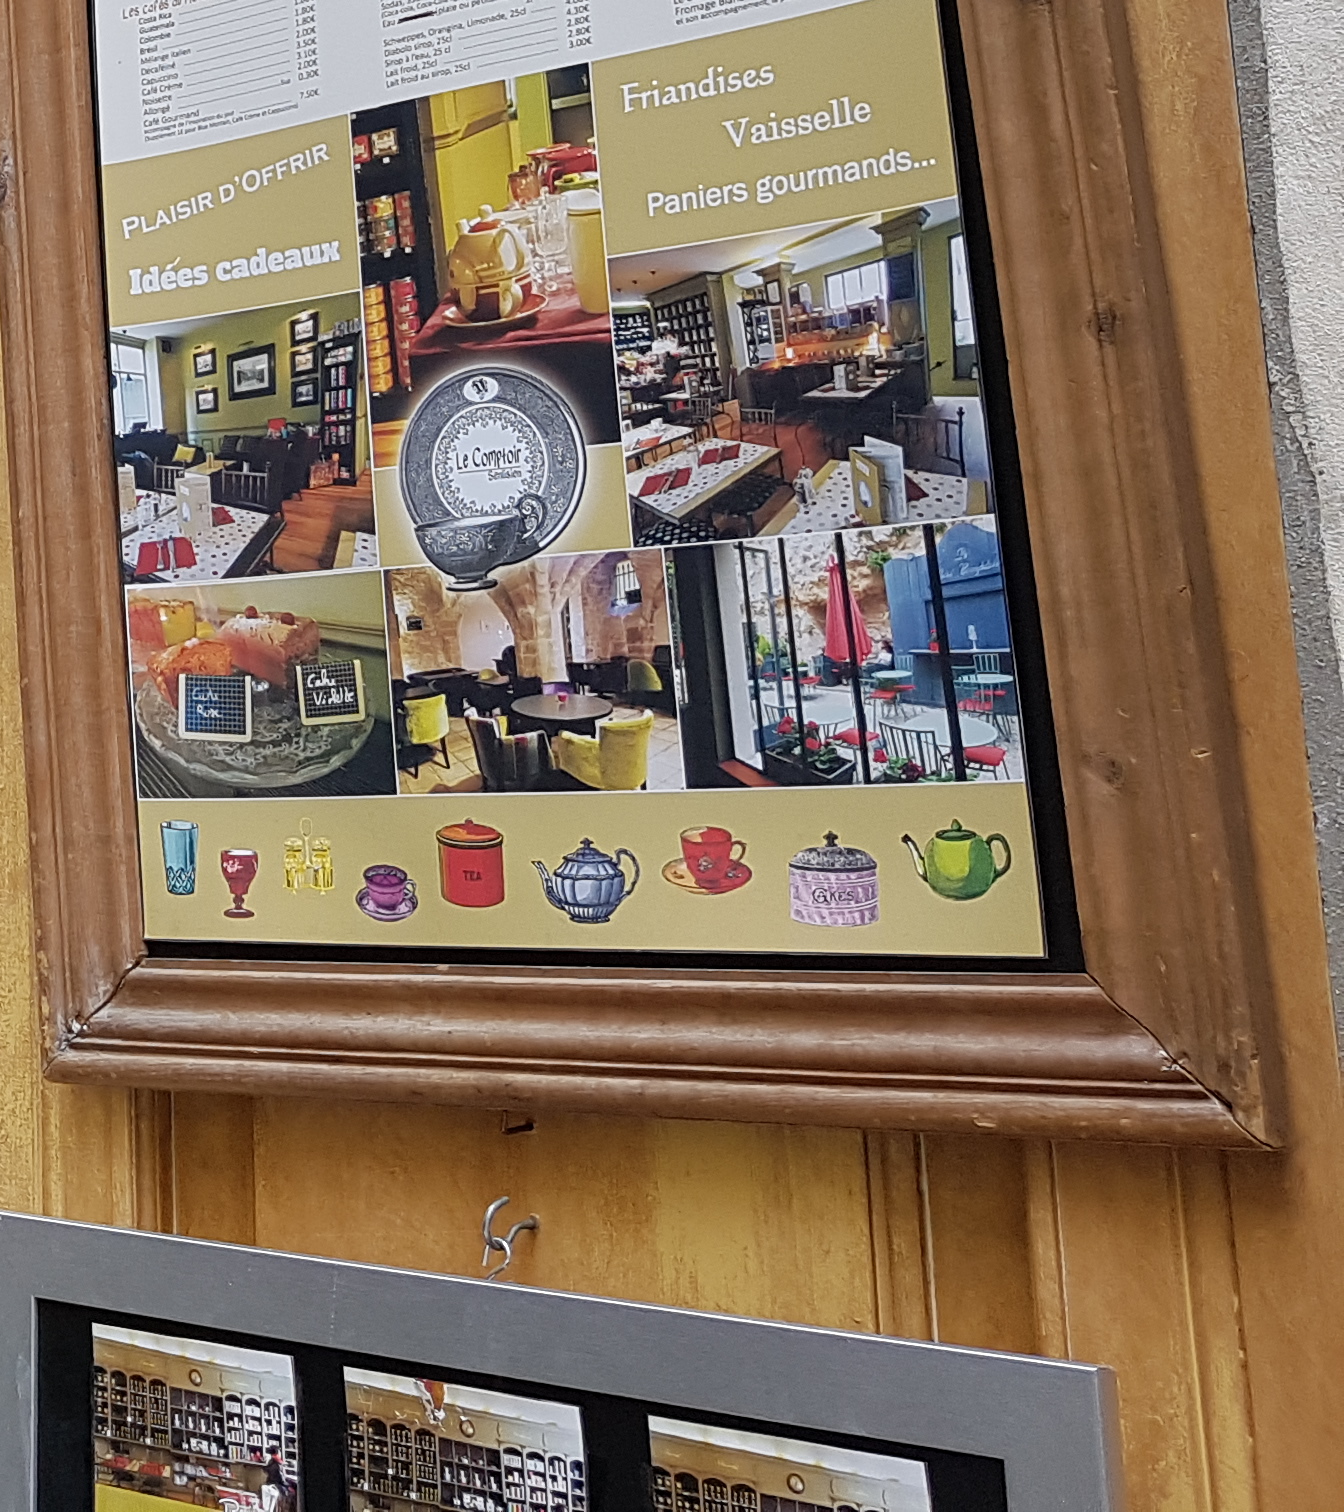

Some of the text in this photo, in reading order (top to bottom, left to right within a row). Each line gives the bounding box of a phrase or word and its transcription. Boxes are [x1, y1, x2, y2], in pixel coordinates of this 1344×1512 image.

[122, 6, 140, 20] Les
[674, 0, 717, 16] Fromage
[620, 62, 774, 116] Friandises
[721, 97, 872, 150] Vaisselle
[121, 144, 330, 240] PLAISIR D'OFFRIR
[646, 180, 748, 218] Paniers
[129, 237, 340, 295] Idées cadeaux
[456, 445, 522, 470] Le Comptoir
[462, 870, 482, 882] TEA
